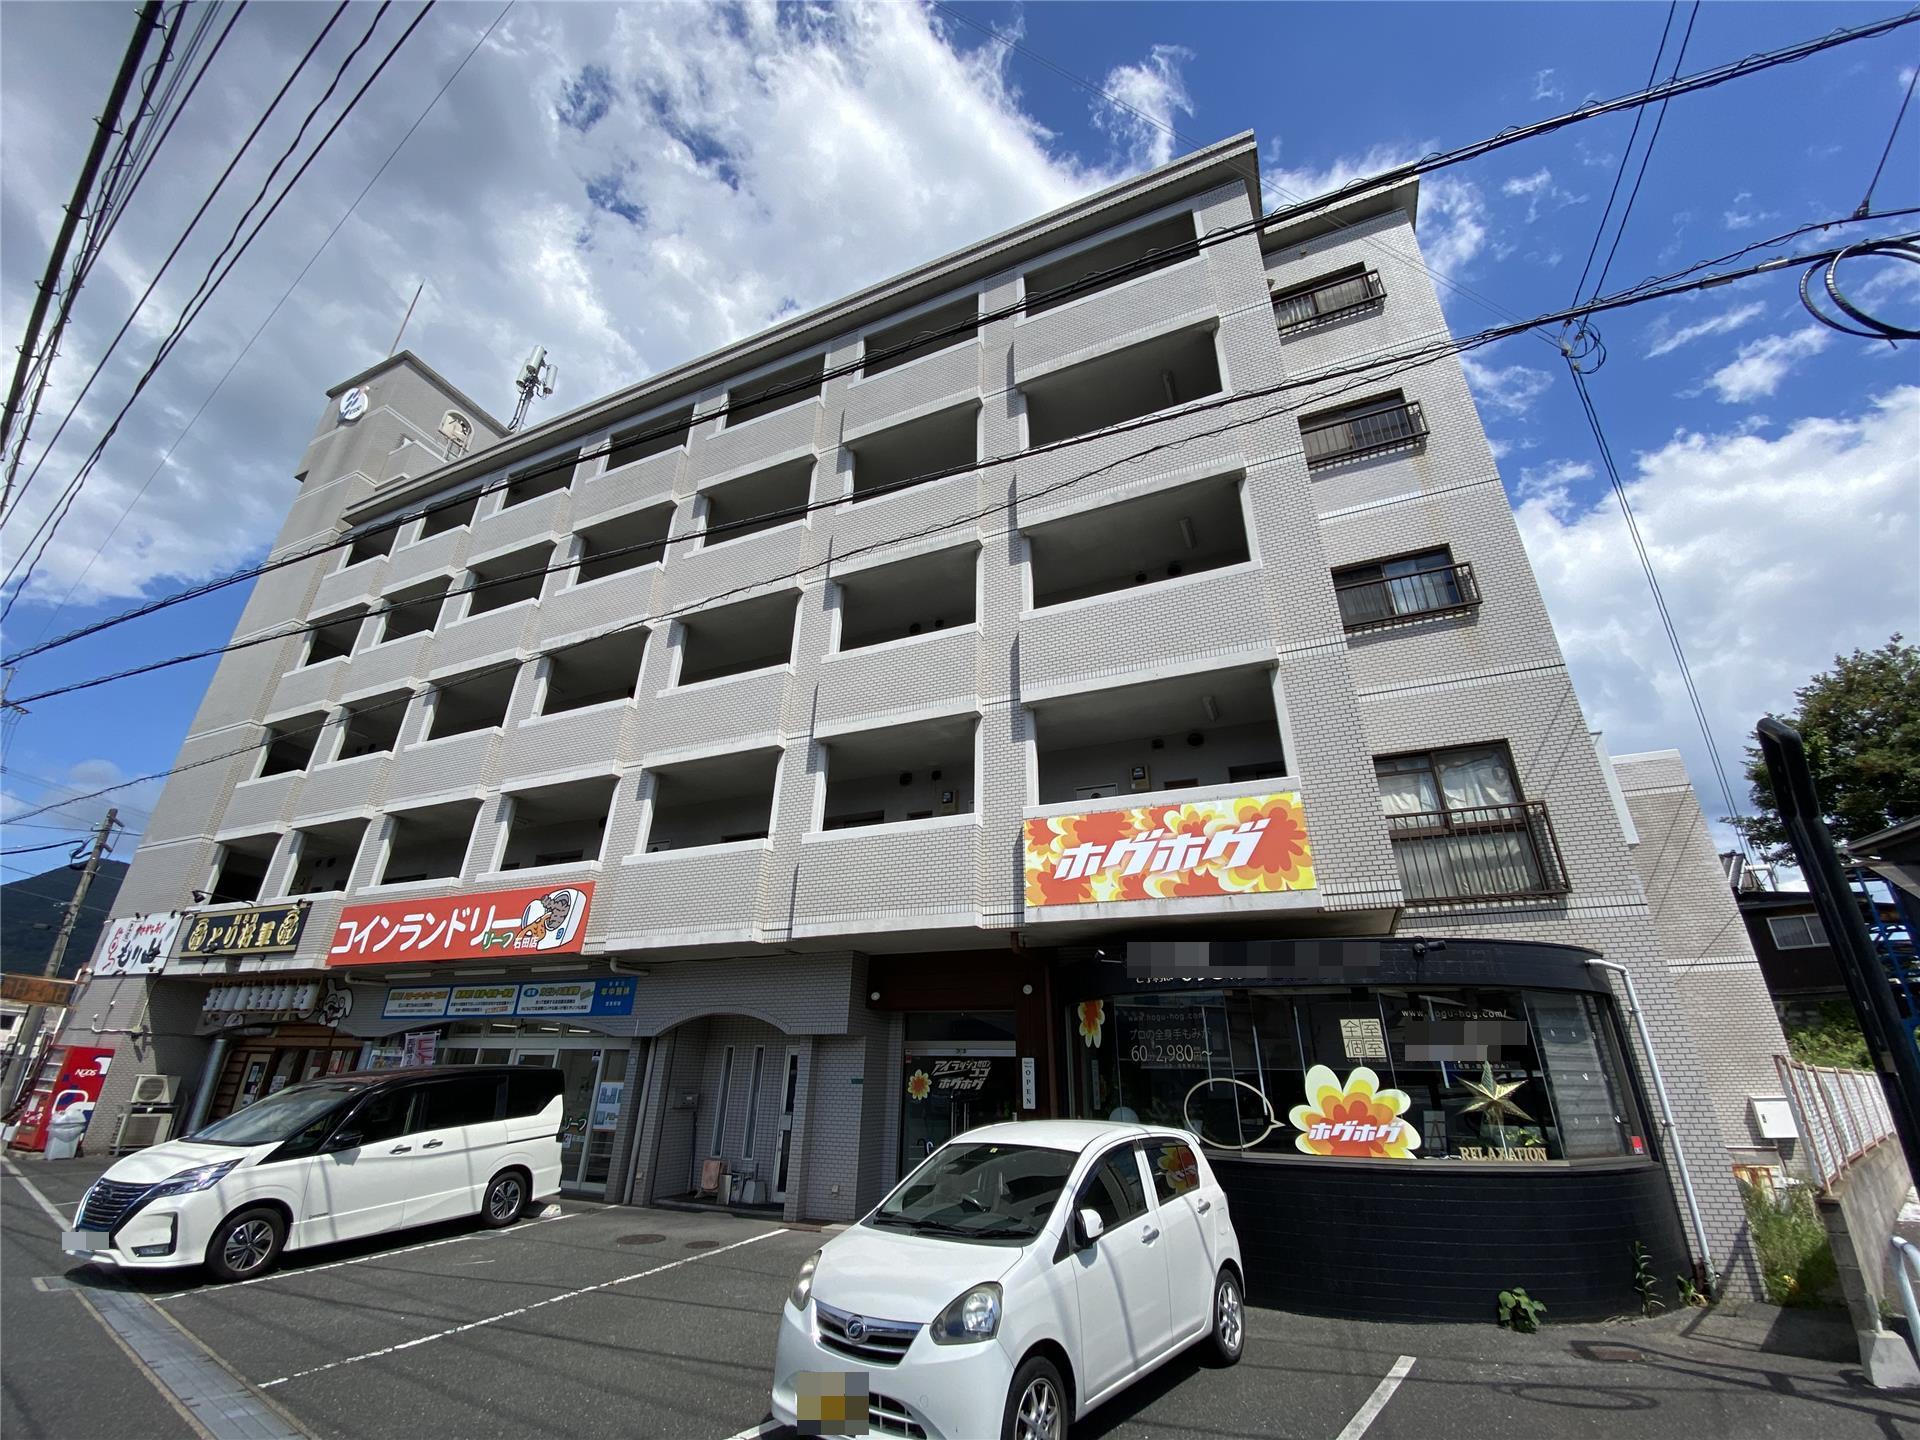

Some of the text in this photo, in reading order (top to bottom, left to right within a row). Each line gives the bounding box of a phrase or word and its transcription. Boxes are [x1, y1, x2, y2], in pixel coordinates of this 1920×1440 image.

[1053, 818, 1271, 881] ホグホグ
[206, 920, 276, 949] とり将軍
[331, 905, 522, 954] コインランドリー
[483, 931, 539, 950] リーフ 石田店
[1342, 1019, 1382, 1039] 全室
[1346, 1039, 1386, 1057] 個室
[938, 1076, 986, 1091] ホグホグ
[1024, 1069, 1032, 1105] OPEN
[1309, 1120, 1403, 1143] ホグホグ
[1459, 1146, 1548, 1161] RELAXATION
